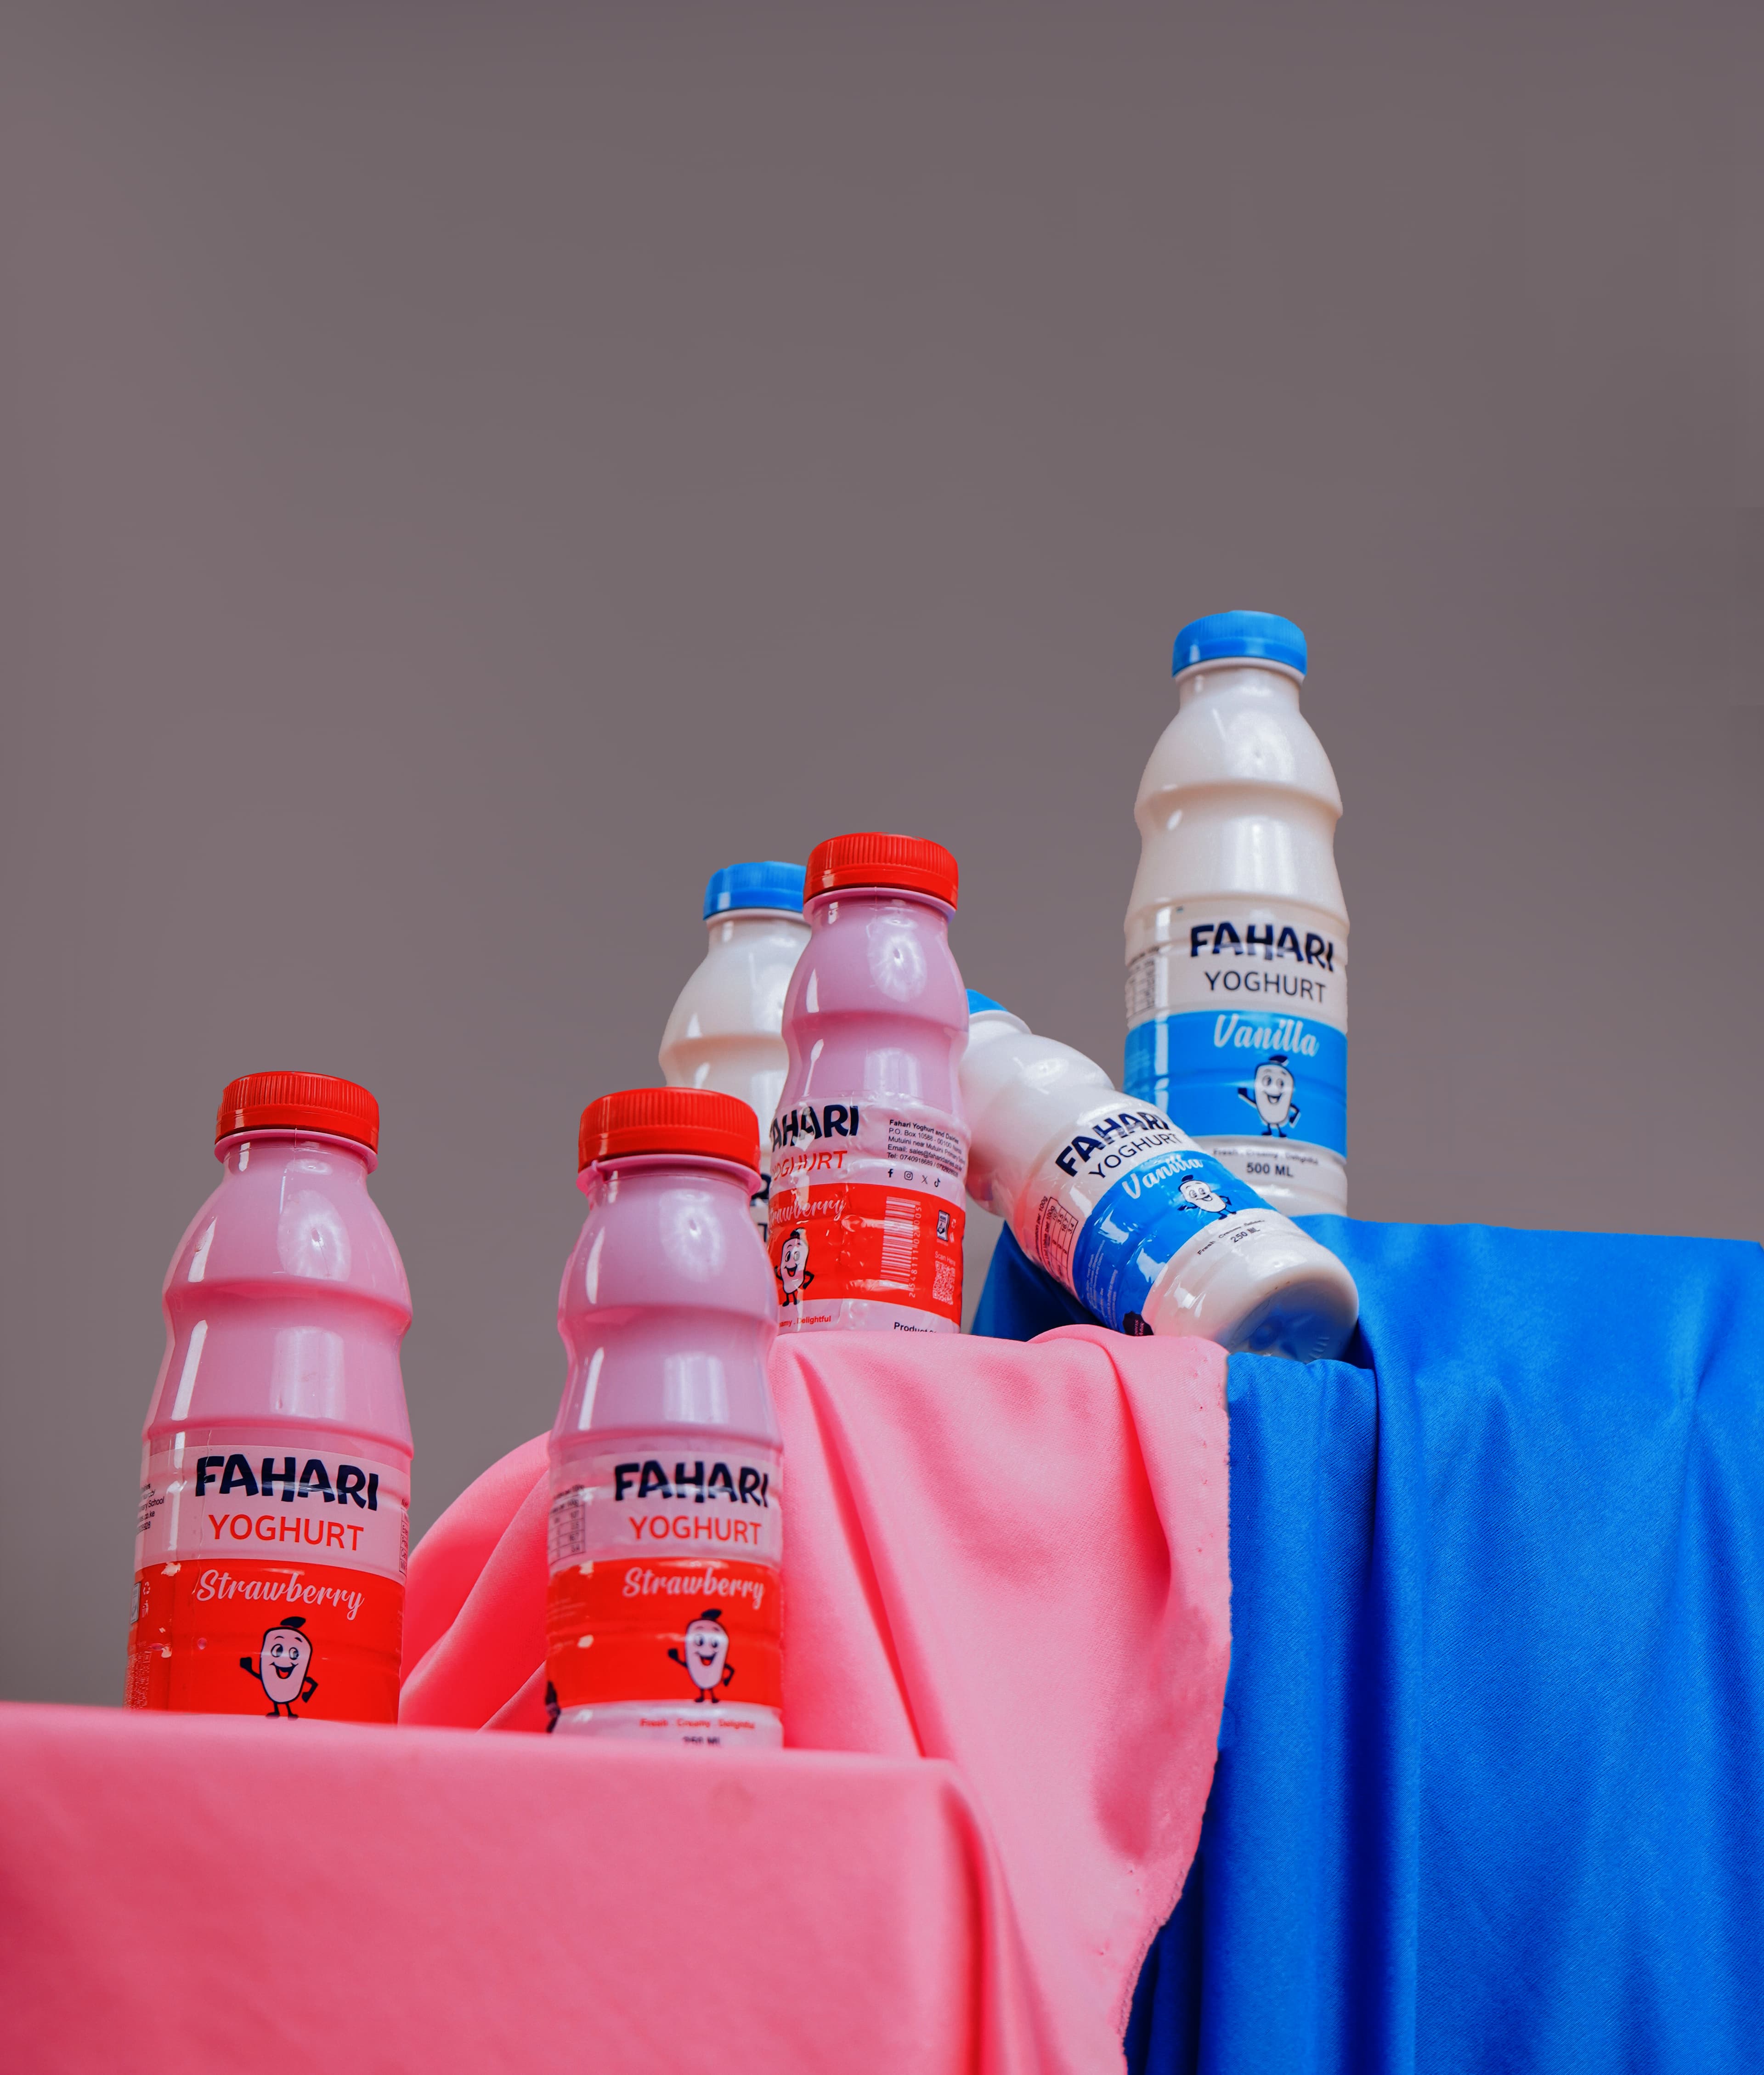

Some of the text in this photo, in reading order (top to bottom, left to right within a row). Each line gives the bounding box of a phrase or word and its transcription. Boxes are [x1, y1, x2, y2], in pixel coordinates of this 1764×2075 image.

[1190, 921, 1334, 972] FAHARI
[1205, 970, 1326, 1003] YOGHURT
[1214, 1014, 1319, 1057] Vanilla
[770, 1104, 859, 1152] AHARI
[889, 1119, 910, 1128] Fahari
[913, 1123, 934, 1134] Yoghurt
[937, 1138, 951, 1148] 00100
[1055, 1112, 1170, 1177] FAHARI
[772, 1150, 848, 1181] OGHURT
[888, 1144, 908, 1153] Email:
[1088, 1134, 1182, 1179] YOGHURT
[1122, 1154, 1204, 1199] Vanilla
[1246, 1162, 1294, 1178] 500 ML
[769, 1197, 846, 1229] trawberry
[1039, 1196, 1048, 1212] 100g
[1230, 1231, 1248, 1243] 250
[195, 1454, 379, 1511] FAHARI
[614, 1460, 769, 1508] FAHARI
[208, 1514, 364, 1551] YOGHURT
[629, 1515, 762, 1545] YOGHURT
[197, 1569, 364, 1621] Strawberry
[623, 1567, 764, 1611] Strawberry
